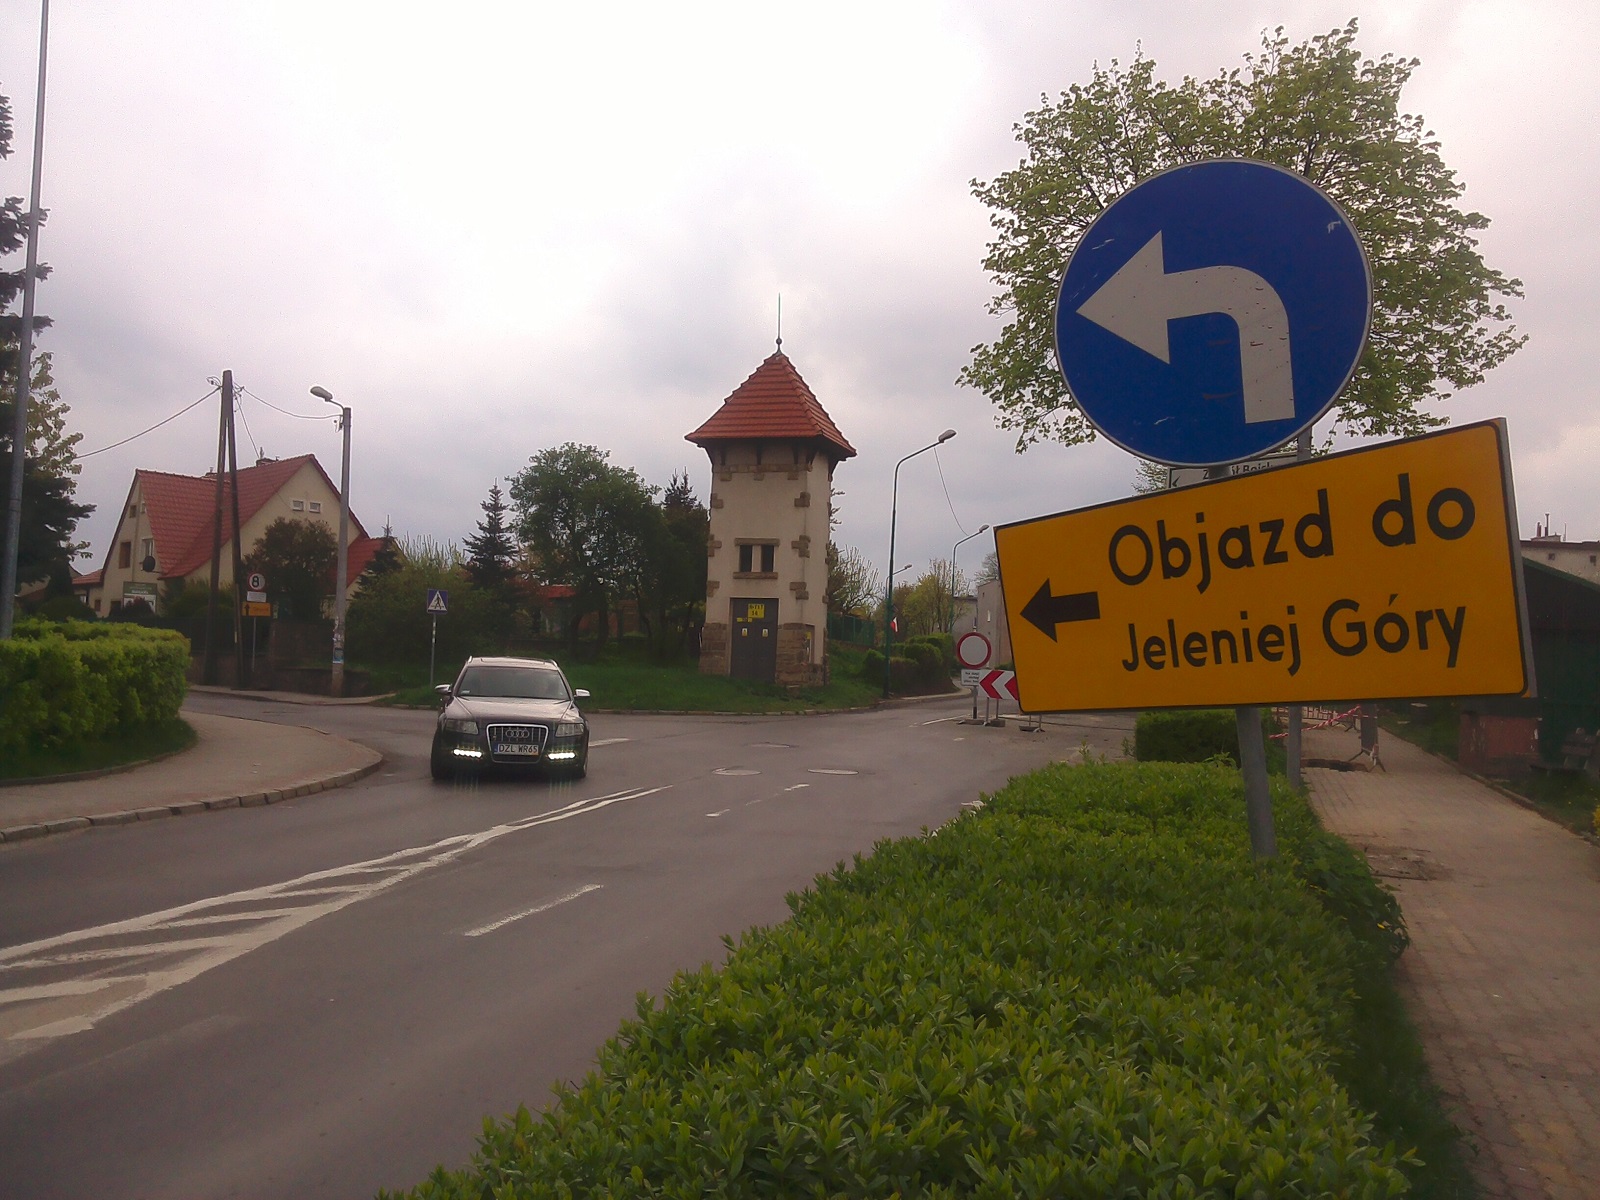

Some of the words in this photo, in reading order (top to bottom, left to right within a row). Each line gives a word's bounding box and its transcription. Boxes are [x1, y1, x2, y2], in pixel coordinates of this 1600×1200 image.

[1108, 488, 1335, 594] Objazd
[1371, 473, 1476, 547] do
[1121, 605, 1302, 677] Jeleniej
[1322, 592, 1466, 668] Góry
[499, 744, 515, 753] DZL
